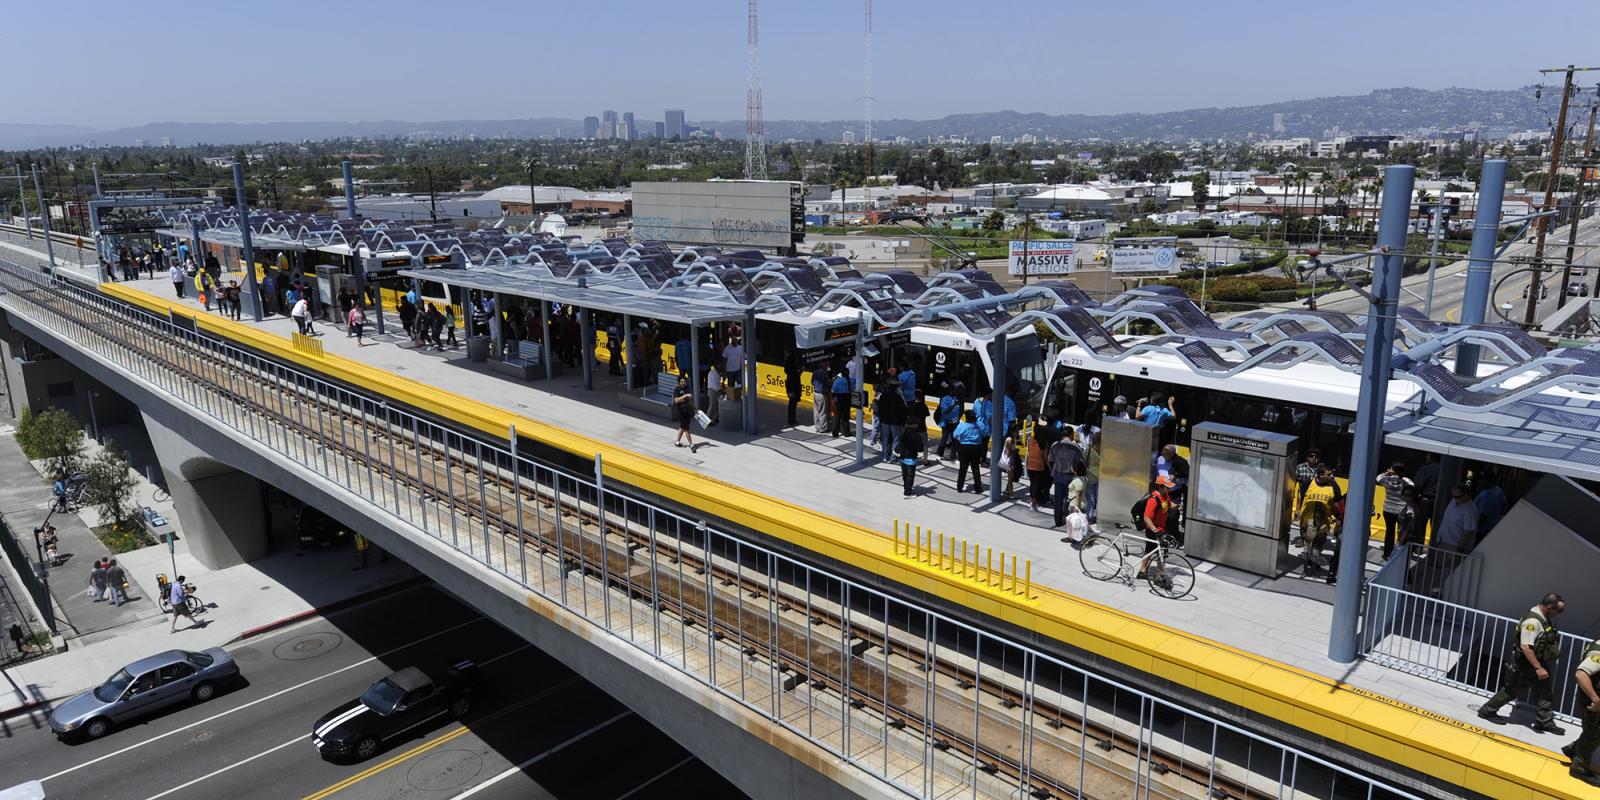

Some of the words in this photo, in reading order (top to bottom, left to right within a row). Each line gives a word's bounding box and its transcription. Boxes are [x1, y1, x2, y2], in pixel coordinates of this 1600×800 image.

[1012, 241, 1044, 250] PAIFIC
[1046, 242, 1073, 250] SALES
[1016, 255, 1069, 266] MASSIVE
[1015, 265, 1069, 273] SELECTION
[1071, 358, 1083, 366] 233
[766, 374, 785, 387] Safe
[1352, 687, 1374, 698] LINE
[1375, 695, 1419, 713] YELLOW
[1421, 710, 1465, 728] BEHIND
[1467, 726, 1496, 738] STAY
